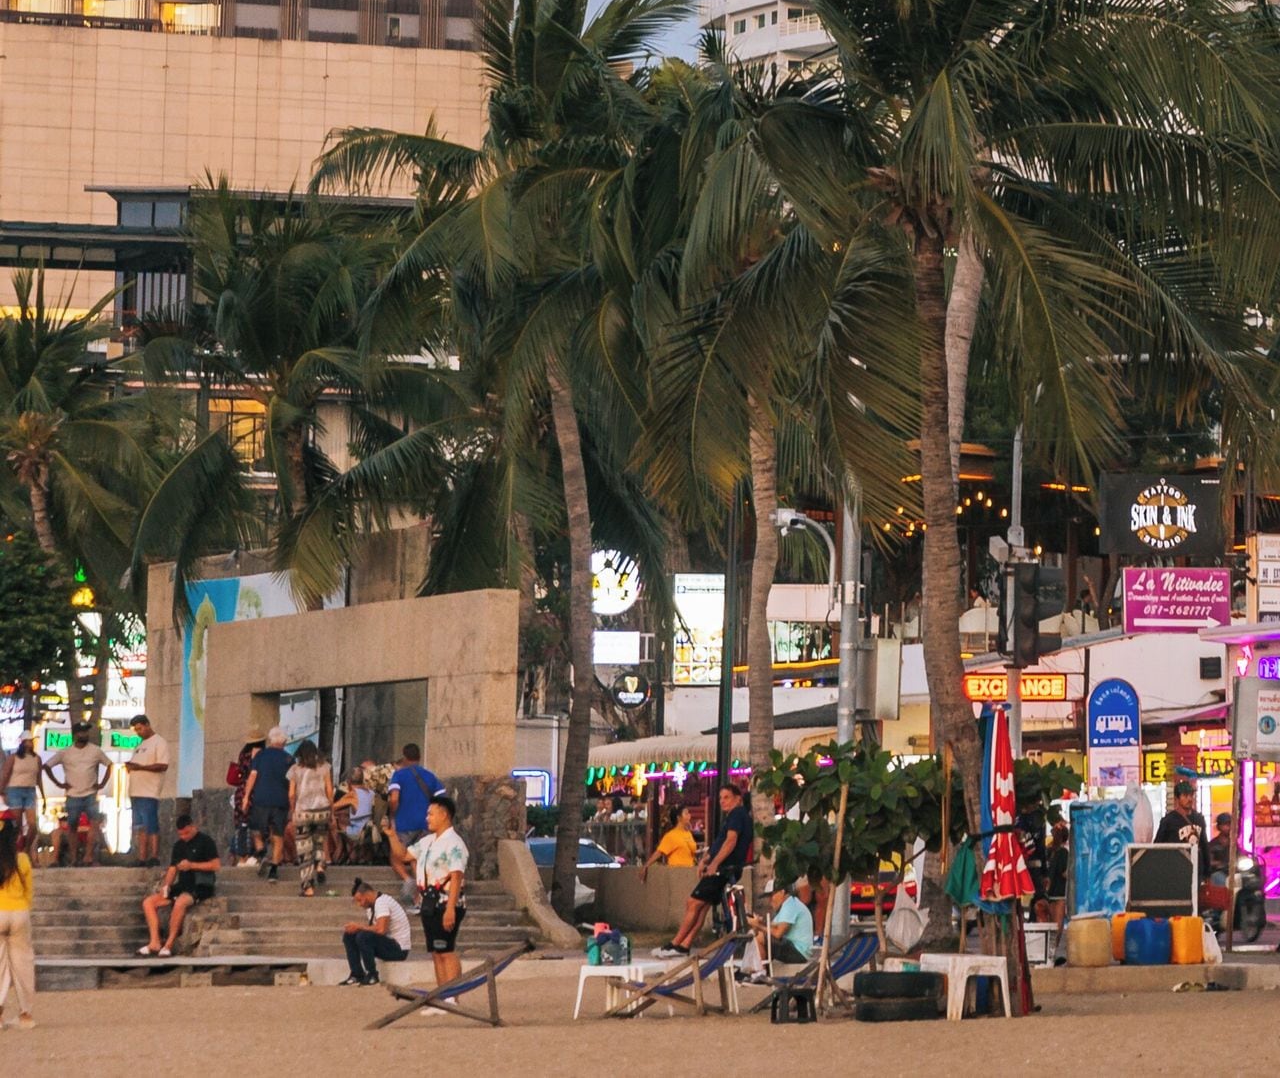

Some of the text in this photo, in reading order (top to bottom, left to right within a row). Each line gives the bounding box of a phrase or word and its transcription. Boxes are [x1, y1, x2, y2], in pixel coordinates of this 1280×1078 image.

[1143, 484, 1181, 499] TATTOO
[1130, 503, 1197, 533] SKIN & INK
[1143, 534, 1182, 549] STUDIO
[1132, 571, 1224, 592] La Nitivadee
[1143, 604, 1212, 616] 081-8621717
